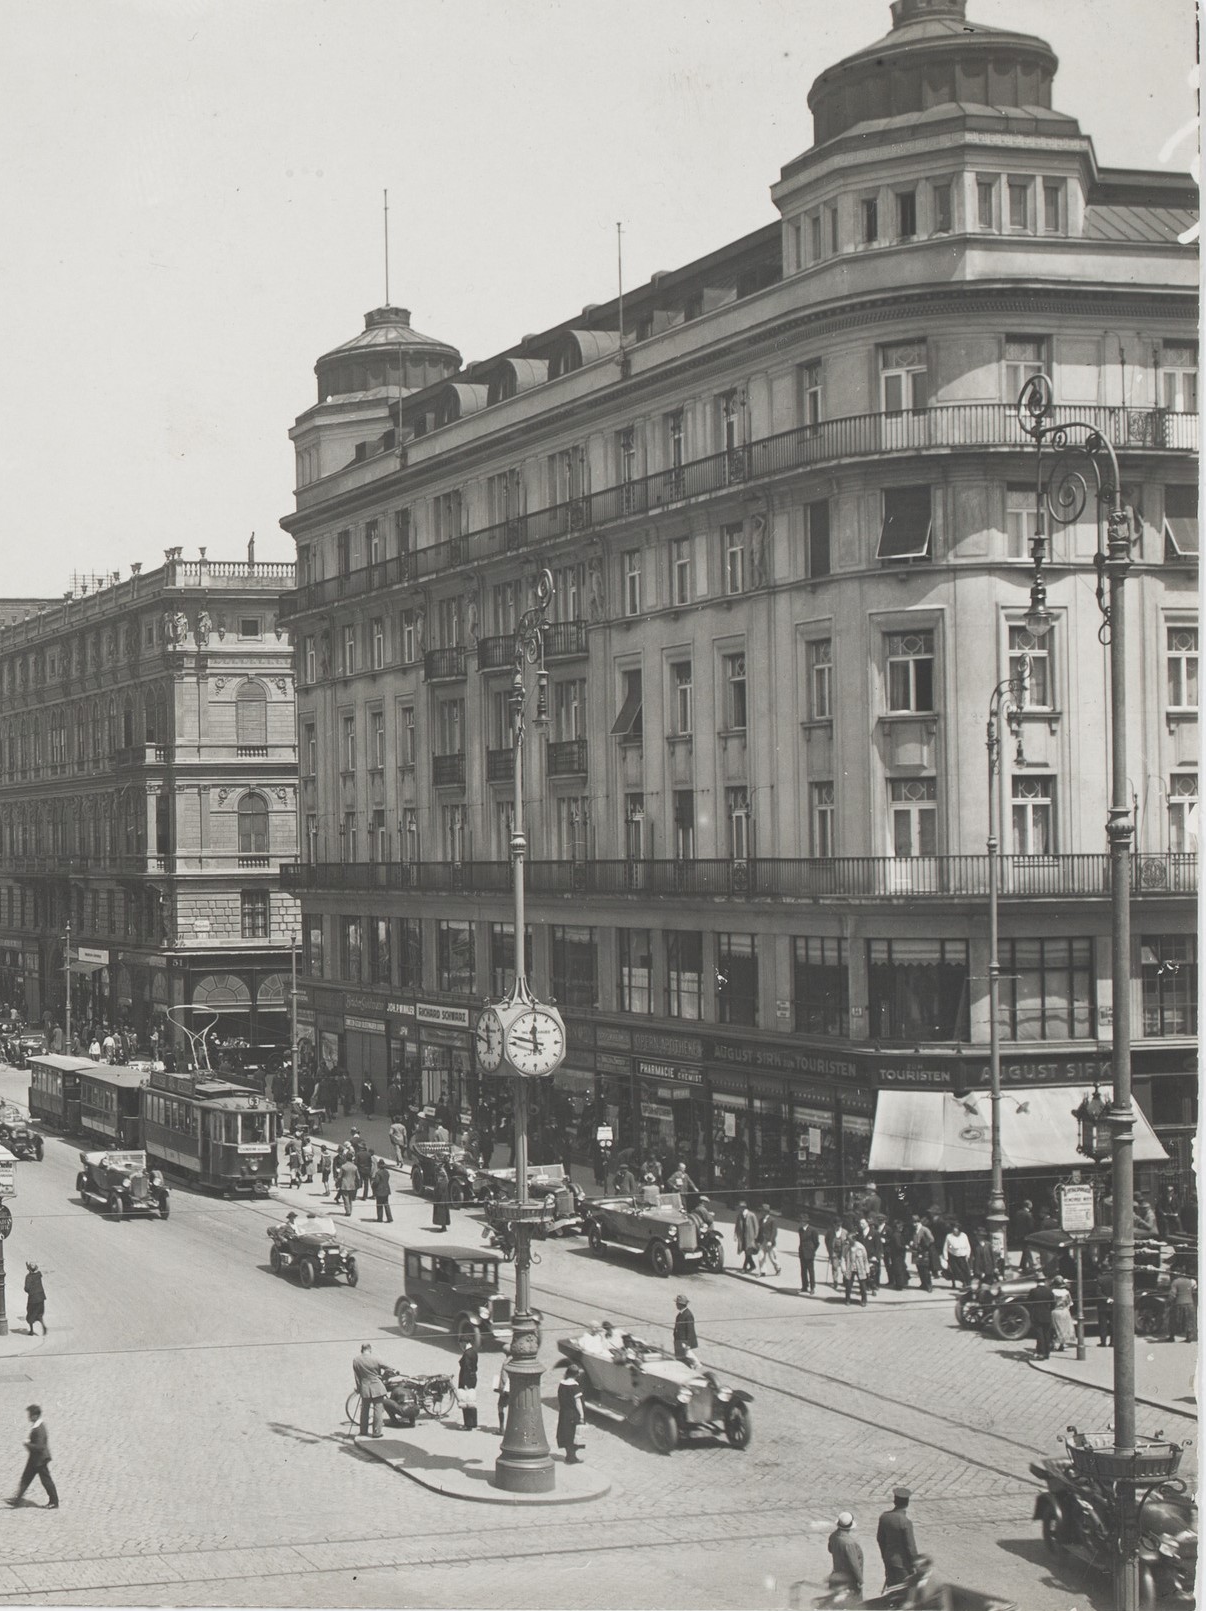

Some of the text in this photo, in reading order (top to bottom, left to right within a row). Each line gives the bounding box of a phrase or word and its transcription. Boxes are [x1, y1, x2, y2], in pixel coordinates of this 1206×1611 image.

[418, 1007, 467, 1023] RICHARD SCHWARZ
[714, 1045, 754, 1063] AUGUST
[756, 1052, 782, 1067] SIRK
[795, 1056, 857, 1077] TOURISTEN
[639, 1062, 675, 1078] PHARMACIE
[677, 1072, 703, 1082] CHEMIST
[879, 1068, 951, 1082] TOURISTEN
[248, 1097, 260, 1106] 63
